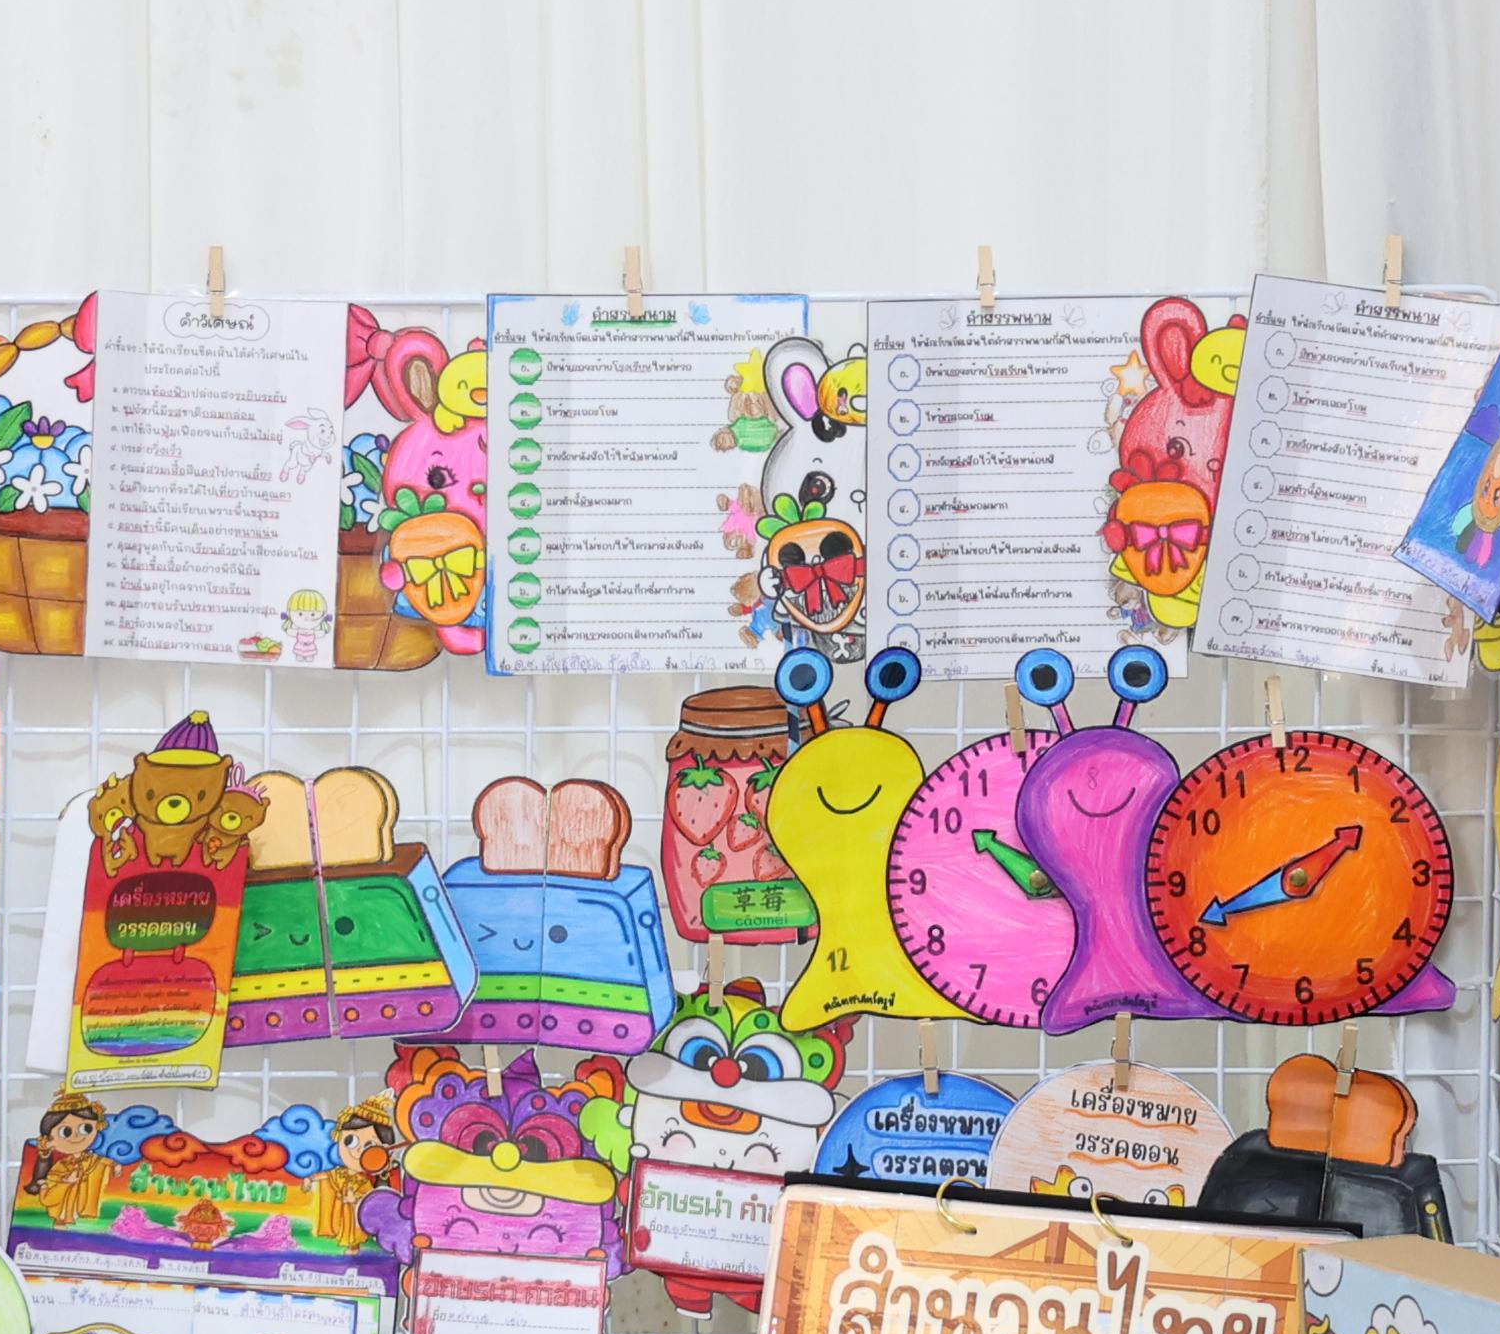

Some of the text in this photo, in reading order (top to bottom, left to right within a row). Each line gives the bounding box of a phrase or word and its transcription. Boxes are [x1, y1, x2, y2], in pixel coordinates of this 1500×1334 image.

[179, 310, 255, 331] คำวิเศษณ์
[592, 305, 677, 323] คำสรพนาม
[1275, 745, 1313, 773] 12
[959, 769, 988, 797] 11
[1216, 770, 1246, 799] 11
[1349, 766, 1364, 793] 1
[928, 807, 962, 834] 10
[1187, 809, 1221, 836] 10
[1390, 798, 1410, 824] 2
[909, 869, 927, 896] 9
[1167, 871, 1186, 897] 9
[1412, 860, 1432, 887] 3
[112, 882, 211, 908] เครื่องหมาย
[732, 884, 787, 913] 草莓
[117, 920, 197, 939] วรรคตอน
[925, 924, 946, 956] 8
[1188, 925, 1208, 957] 8
[1393, 917, 1415, 946] 4
[826, 947, 851, 973] 12
[1356, 957, 1375, 986] 5
[969, 964, 987, 990] 7
[1232, 964, 1250, 989] 7
[1294, 976, 1314, 1005] 6
[1030, 977, 1049, 1007] 6
[1070, 1078, 1198, 1128] เครื่องหมาย
[873, 1097, 1000, 1139] เครื่องหมาย
[1075, 1131, 1180, 1166] วรรคตอน
[881, 1151, 988, 1179] วรรคตอน
[129, 1162, 289, 1204] สำนวนไทย
